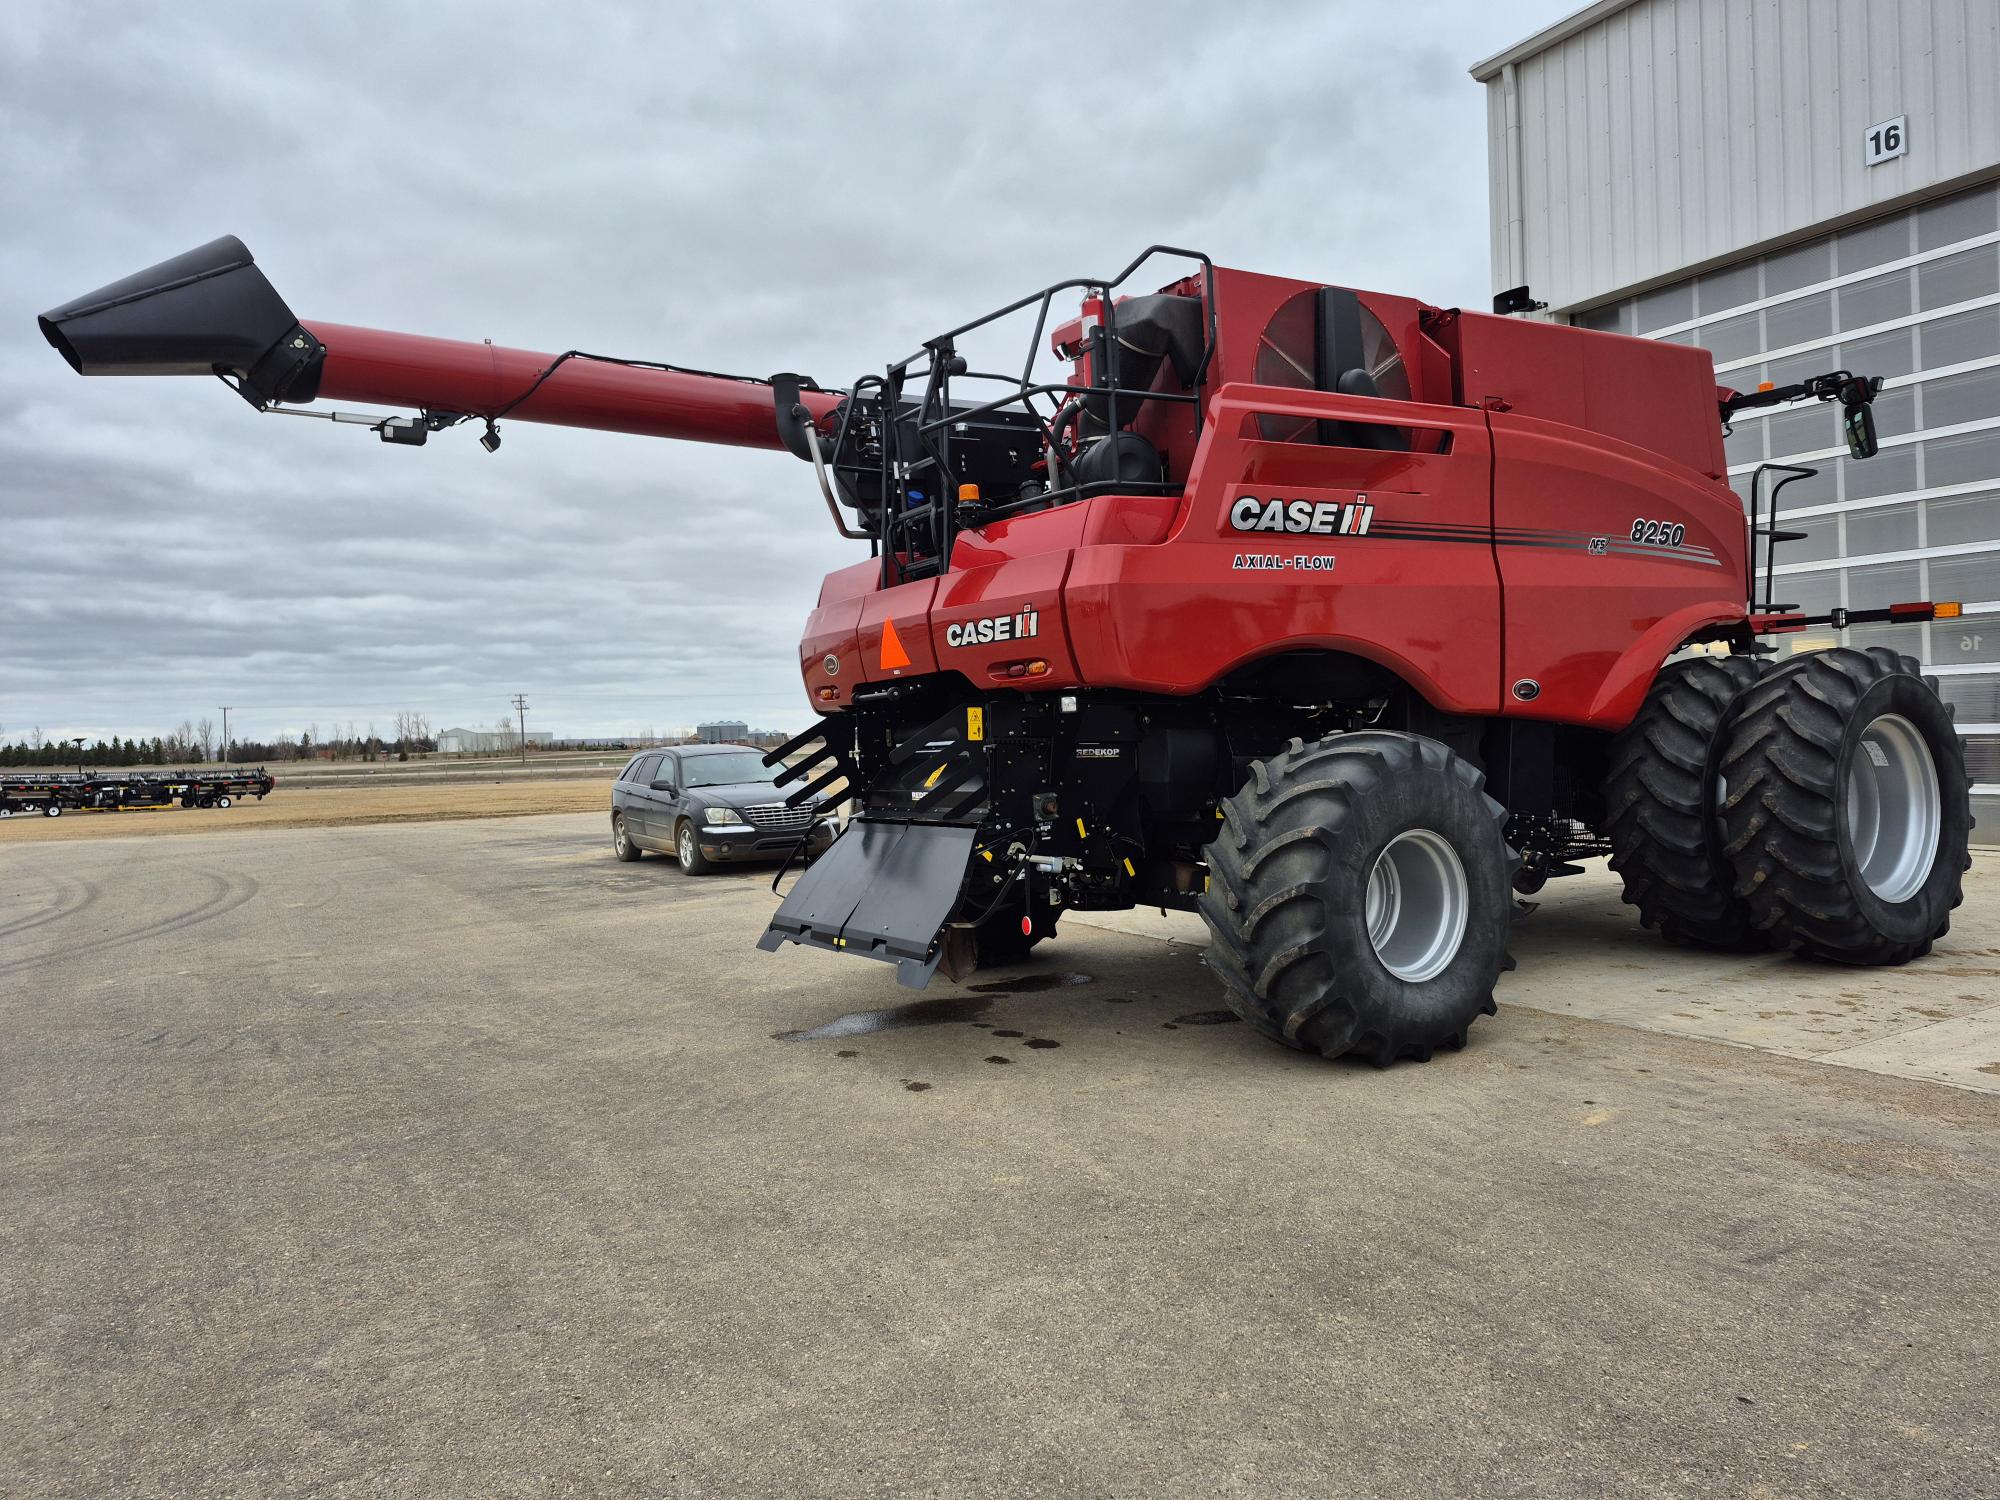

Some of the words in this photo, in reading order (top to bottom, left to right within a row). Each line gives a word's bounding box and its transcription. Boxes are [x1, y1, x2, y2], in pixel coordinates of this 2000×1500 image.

[1869, 125, 1901, 156] 16
[1230, 497, 1338, 534] CASE
[1588, 537, 1608, 550] AFS
[1630, 517, 1685, 548] 8250
[946, 616, 1011, 647] CASE
[1076, 748, 1120, 756] REDEKOP
